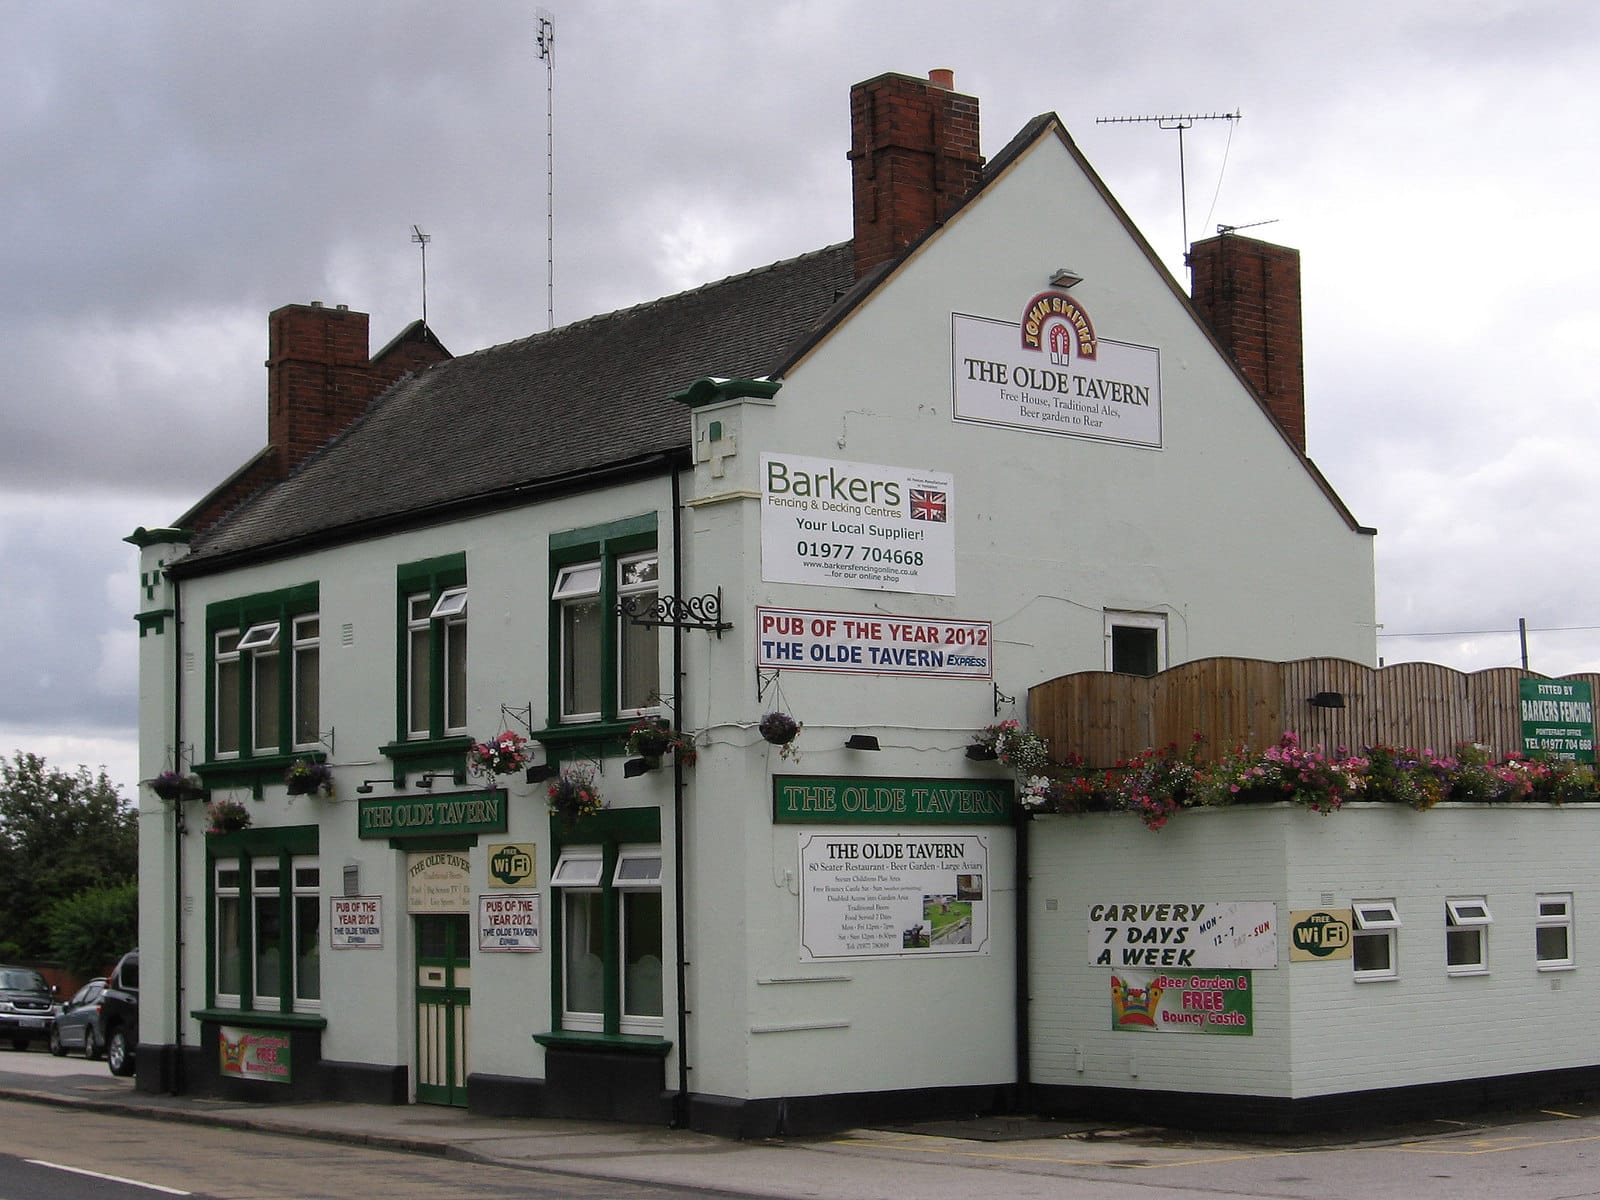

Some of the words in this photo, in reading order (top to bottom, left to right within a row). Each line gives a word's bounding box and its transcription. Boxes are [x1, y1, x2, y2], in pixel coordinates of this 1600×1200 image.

[1026, 299, 1051, 347] JOHN
[1052, 298, 1097, 355] SMITH'S
[964, 358, 1008, 385] THE
[1013, 366, 1069, 394] OLDE
[1073, 376, 1150, 407] TAVERN
[1000, 389, 1018, 402] Free
[1021, 392, 1051, 407] House,
[1053, 397, 1099, 414] Traditional
[1101, 402, 1121, 418] Ales,
[1020, 407, 1039, 419] Beer
[1042, 410, 1070, 424] garden
[1072, 415, 1081, 425] to
[1083, 416, 1103, 428] Rear
[767, 461, 901, 506] Barkers
[768, 496, 808, 510] Fencing
[811, 500, 819, 510] &
[822, 501, 861, 516] Decking
[864, 506, 902, 519] Centres
[796, 517, 828, 532] Your
[831, 521, 865, 535] Local
[868, 525, 925, 541] Supplier!
[797, 541, 853, 560] 01977
[861, 547, 924, 567] 704668
[803, 560, 918, 577] www.barkersfencingonline.co.uk
[843, 572, 857, 580] our
[858, 572, 881, 581] online
[883, 574, 900, 583] shop
[762, 615, 804, 635] PUB
[811, 619, 837, 637] OF
[843, 621, 882, 640] THE
[888, 624, 939, 643] YEAR
[945, 628, 987, 646] 2012
[762, 641, 803, 660] THE
[810, 643, 862, 663] OLDE
[868, 647, 943, 667] TAVERN
[1538, 685, 1562, 695] FITTED
[1564, 686, 1573, 695] BY
[1522, 700, 1559, 721] BARKERS
[1560, 701, 1591, 723] FENCING
[1525, 738, 1539, 749] TEL
[1541, 738, 1564, 750] 01977
[1565, 739, 1578, 750] 704
[784, 787, 837, 812] THE
[841, 788, 907, 813] OLDE
[912, 789, 1004, 814] TAVERN
[363, 806, 393, 828] THE
[396, 803, 434, 827] OLDE
[437, 800, 499, 825] TAVERN
[827, 844, 858, 859] THE
[862, 844, 903, 859] OLDE
[906, 844, 964, 859] TAVERN
[409, 860, 425, 878] THE
[426, 854, 445, 867] OLDE
[447, 854, 470, 874] TAVER
[809, 863, 819, 871] 80
[820, 863, 843, 871] Seater
[845, 863, 885, 871] Restaurant
[890, 862, 907, 871] Beer
[909, 862, 935, 870] Garden
[941, 862, 960, 872] Large
[336, 902, 350, 912] PUB
[351, 902, 360, 912] OF
[362, 902, 376, 912] THE
[486, 902, 502, 912] PUB
[505, 901, 517, 911] OF
[518, 901, 533, 911] THE
[1090, 903, 1204, 922] CARVERY
[339, 915, 357, 925] YEAR
[358, 914, 374, 925] 2012
[488, 915, 511, 926] YEAR
[512, 915, 532, 925] 2012
[1199, 917, 1217, 935] MON
[1311, 915, 1331, 924] FREE
[483, 928, 494, 936] THE
[496, 928, 512, 936] OLDE
[512, 928, 538, 936] TAVERN
[1104, 927, 1118, 944] 7
[1127, 927, 1189, 944] DAYS
[1254, 921, 1270, 937] SUN
[1214, 935, 1223, 946] 12
[1097, 949, 1112, 966] A
[1122, 948, 1195, 967] WEEK
[1159, 976, 1187, 989] Beer
[1190, 976, 1234, 990] Garden
[1238, 976, 1247, 990] &
[1182, 991, 1224, 1010] FREE
[1162, 1010, 1205, 1027] Bouncy
[1208, 1011, 1246, 1025] Castle
